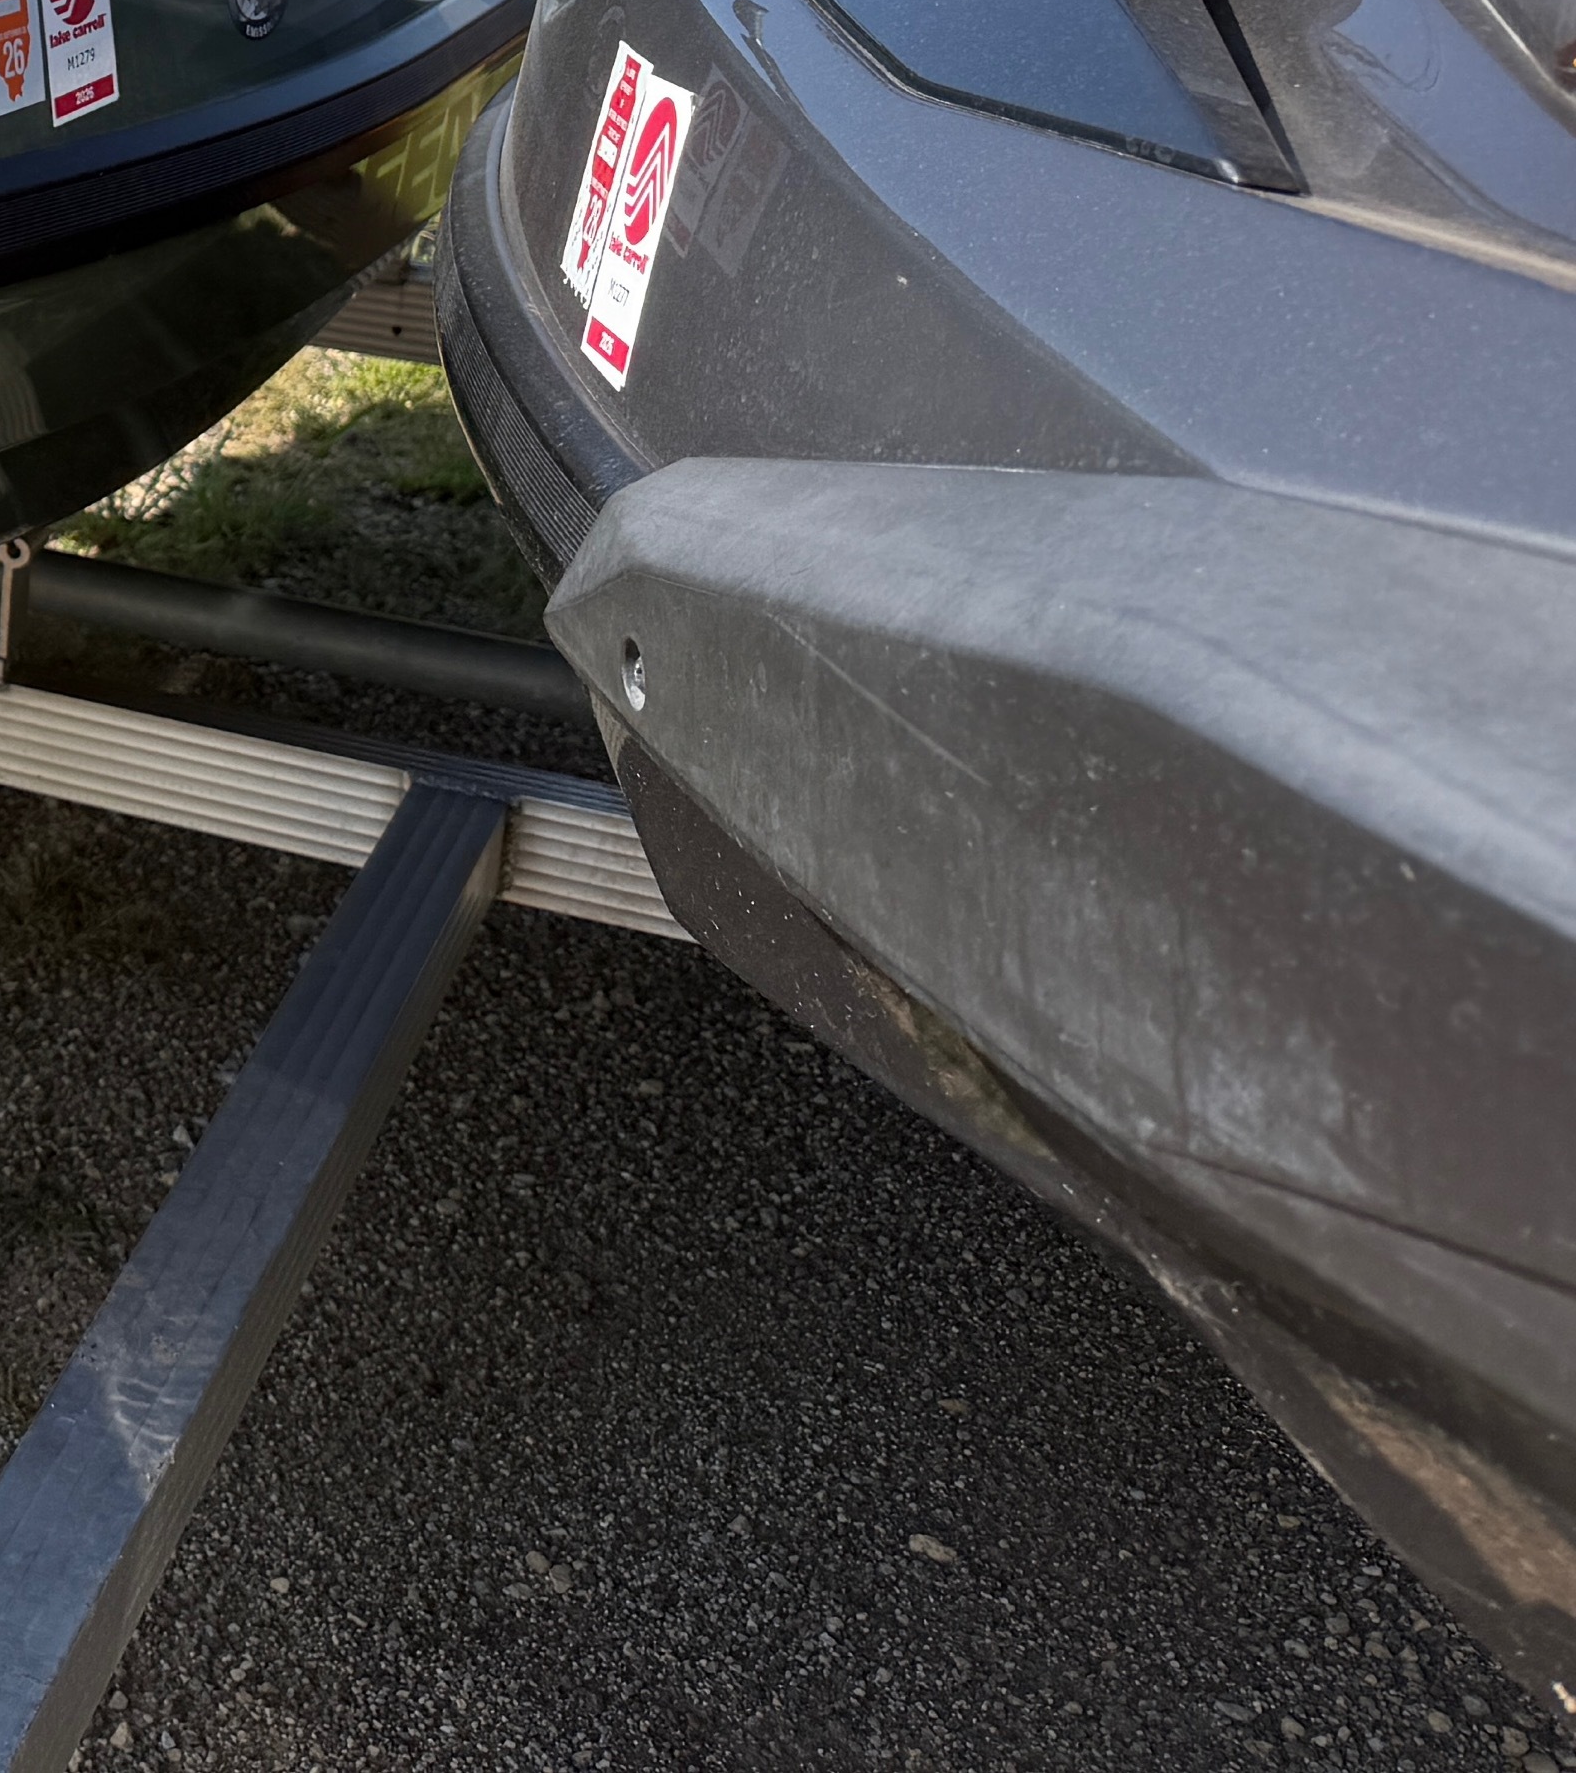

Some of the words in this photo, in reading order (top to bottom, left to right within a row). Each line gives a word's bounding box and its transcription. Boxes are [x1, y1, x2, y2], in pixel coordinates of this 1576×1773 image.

[49, 30, 71, 49] lake
[72, 12, 107, 39] carroll
[2, 37, 26, 79] 26
